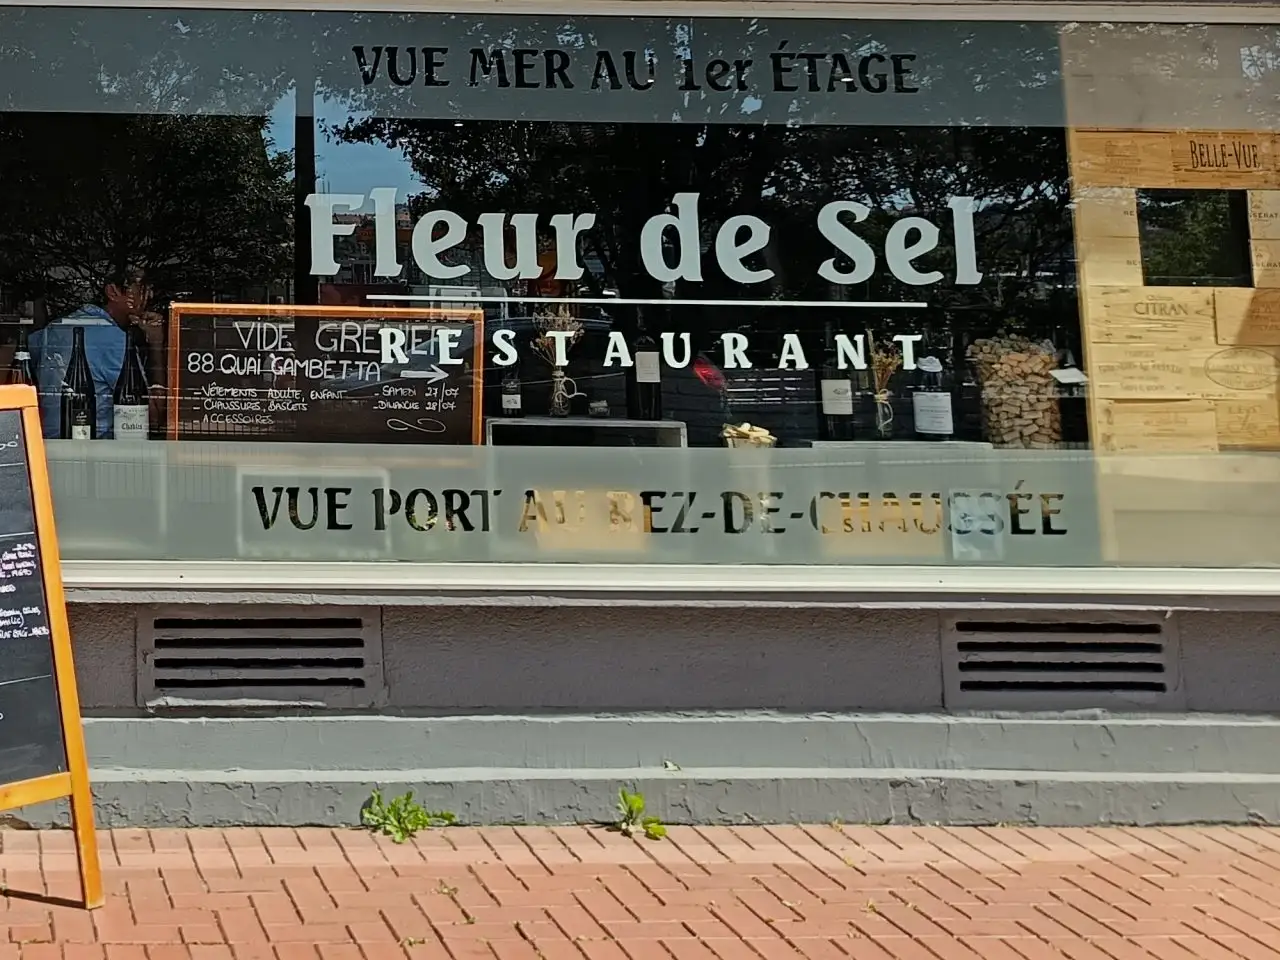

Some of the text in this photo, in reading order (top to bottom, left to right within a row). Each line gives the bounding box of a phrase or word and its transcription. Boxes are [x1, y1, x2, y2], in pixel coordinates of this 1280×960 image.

[352, 42, 920, 93] VUE MER AU 1er ÉTAGE
[304, 188, 983, 286] Fleur de Sel
[1134, 302, 1189, 316] CITRAN
[234, 317, 295, 352] VIDE
[378, 328, 923, 371] RESTAURANT
[188, 353, 381, 380] 88 QUAI GAMBETTA
[202, 382, 257, 398] VÊTEMENTS
[311, 390, 347, 400] ENFANT
[383, 382, 459, 402] SAMEDI 27/07
[204, 414, 273, 424] ACCESSOIRES
[252, 487, 352, 530] VUE
[372, 489, 502, 531] PORT
